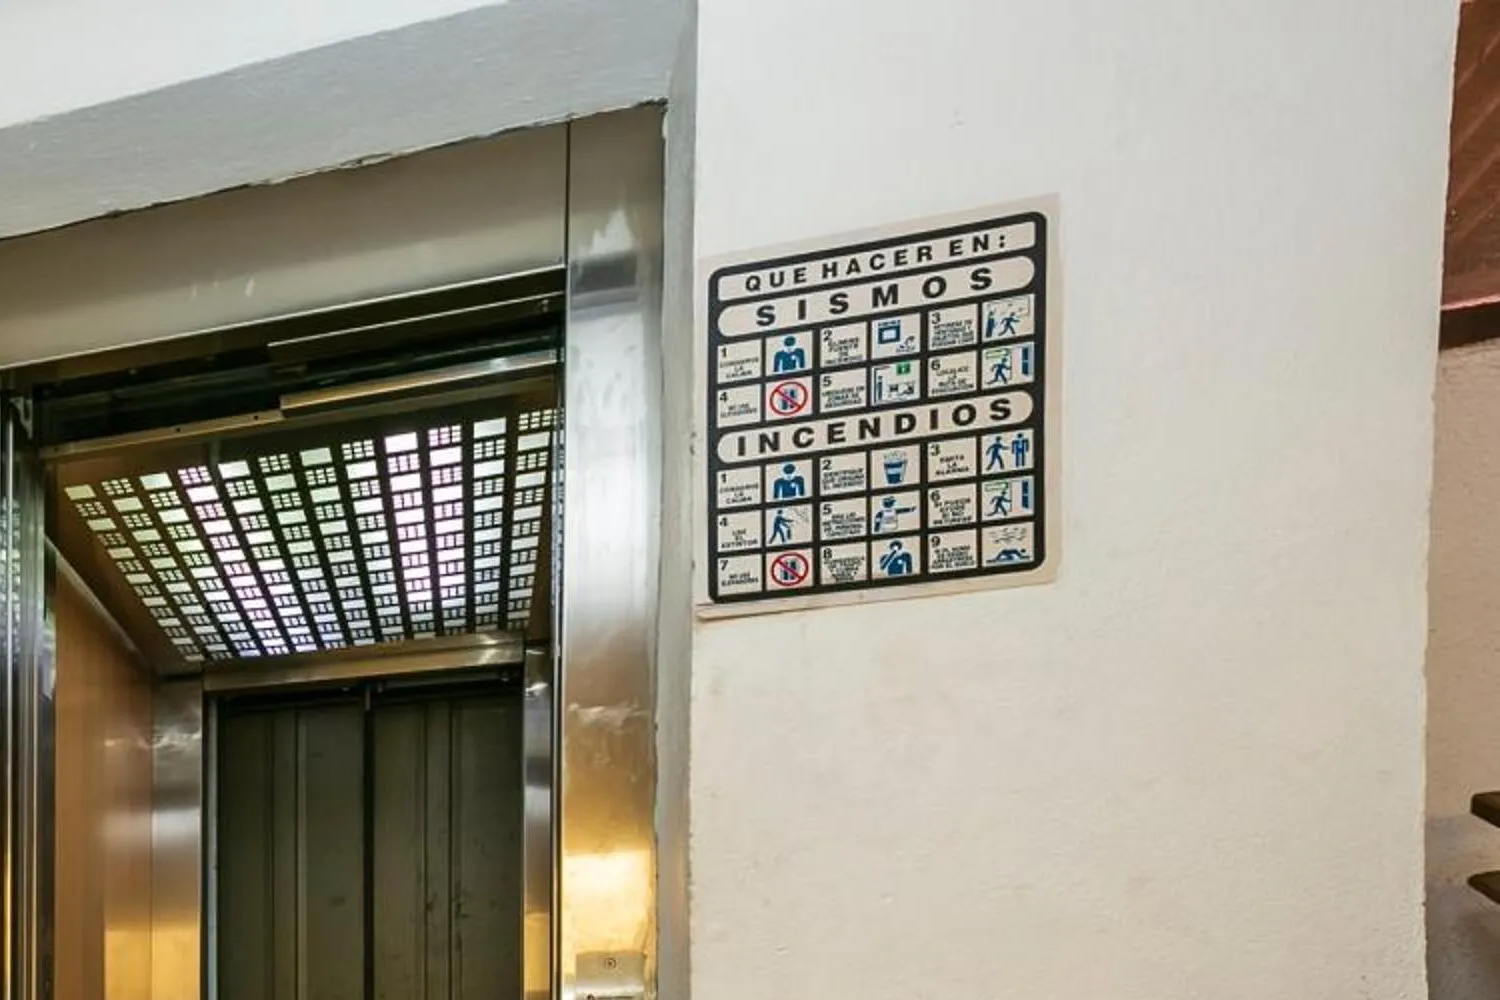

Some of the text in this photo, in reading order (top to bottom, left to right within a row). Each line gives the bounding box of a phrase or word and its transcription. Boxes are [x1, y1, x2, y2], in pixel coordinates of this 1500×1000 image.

[745, 233, 1007, 292] QUE HACER EN:
[756, 267, 993, 327] SISMOS
[931, 312, 941, 324] 3
[823, 329, 833, 342] 2
[720, 347, 728, 358] 1
[931, 359, 941, 371] 6
[823, 376, 832, 387] 5
[719, 391, 728, 402] 4
[738, 398, 1012, 457] INCENDIOS
[930, 444, 941, 456] 3
[822, 459, 832, 470] 2
[720, 473, 727, 483] 1
[930, 490, 941, 501] 6
[823, 504, 832, 515] 5
[719, 516, 728, 527] 4
[930, 535, 941, 547] 9
[823, 547, 833, 559] 8
[720, 559, 729, 571] 7
